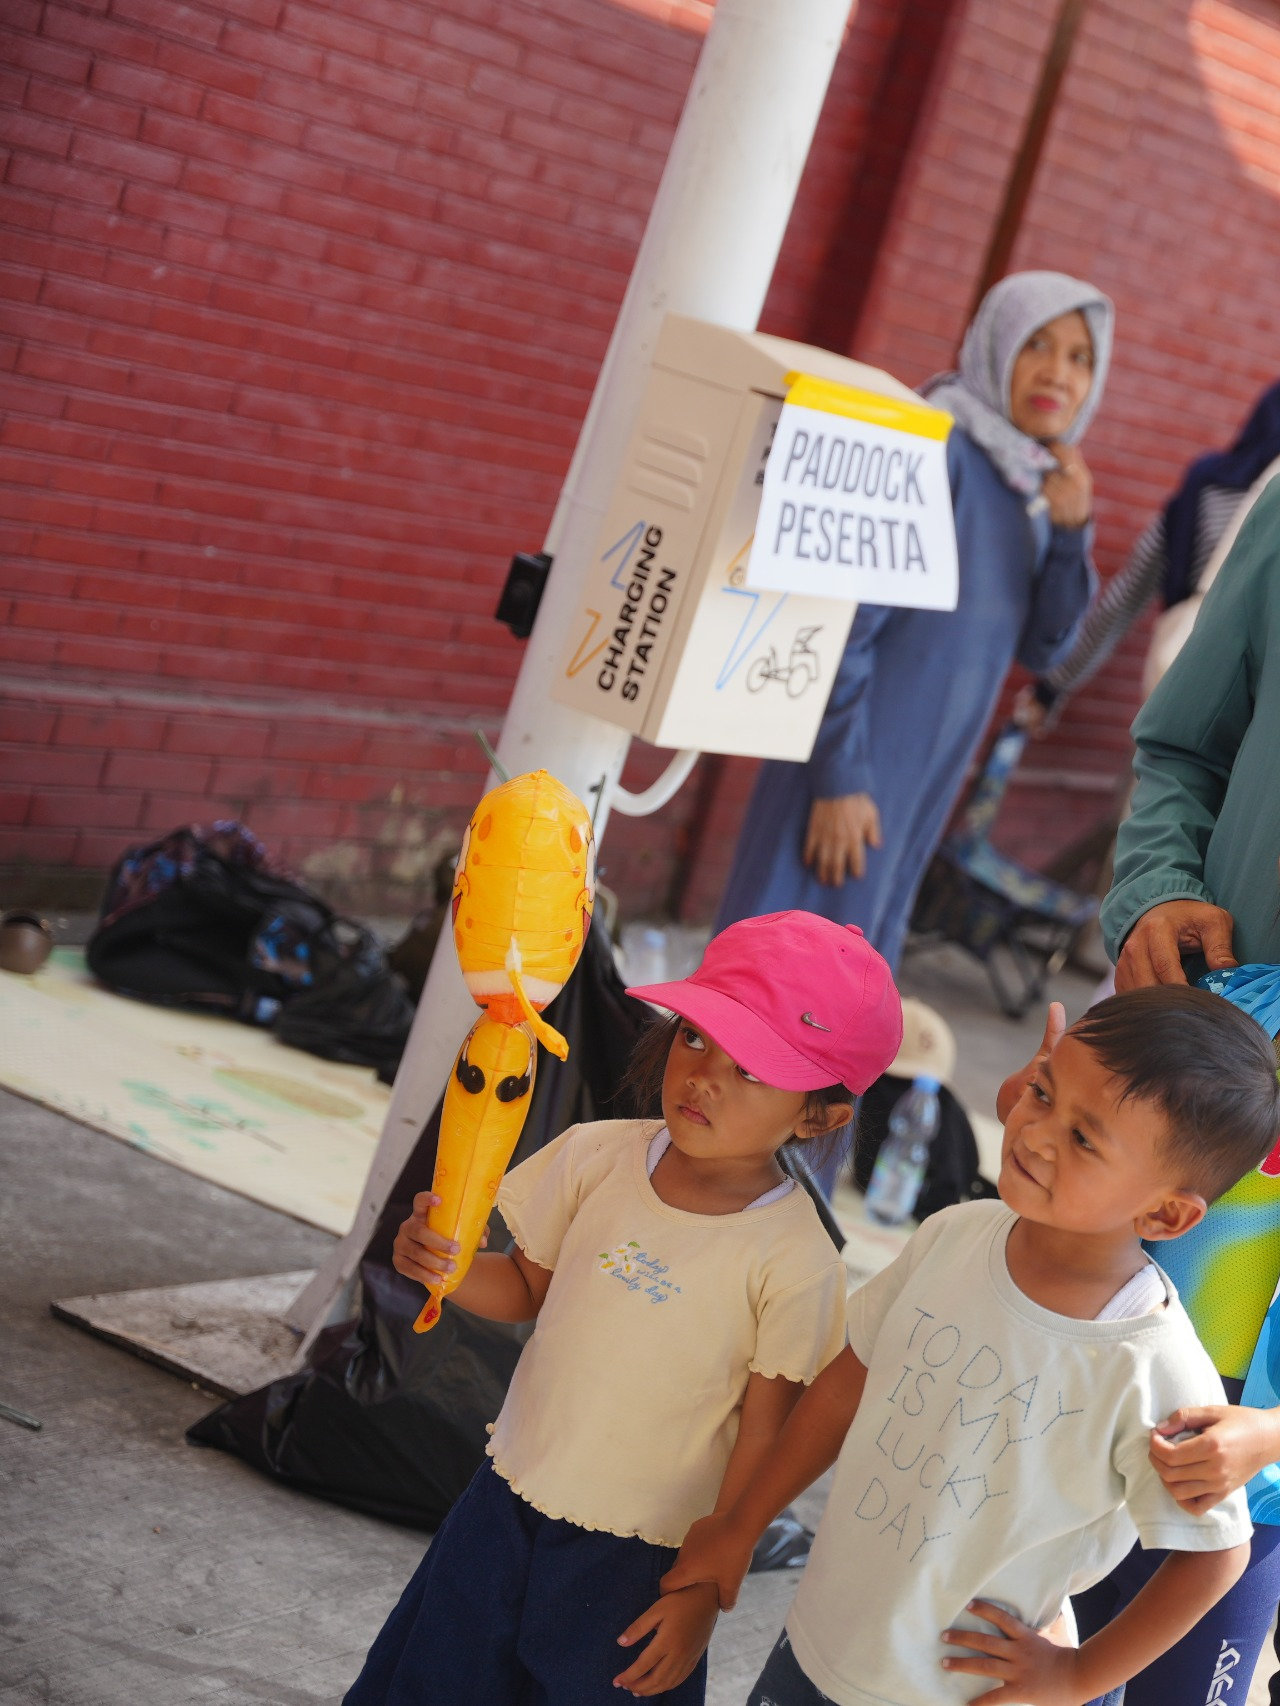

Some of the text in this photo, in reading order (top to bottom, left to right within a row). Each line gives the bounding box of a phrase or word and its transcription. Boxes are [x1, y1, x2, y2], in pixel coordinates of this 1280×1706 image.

[783, 430, 926, 505] PADDOCK
[772, 502, 929, 574] PESERTA
[597, 525, 663, 692] CHARGING
[621, 567, 678, 702] STATION
[887, 1365, 1034, 1465] IS MY
[907, 1307, 1084, 1436] TODAY
[875, 1416, 1009, 1520] LUCKY
[855, 1477, 952, 1563] DAY
